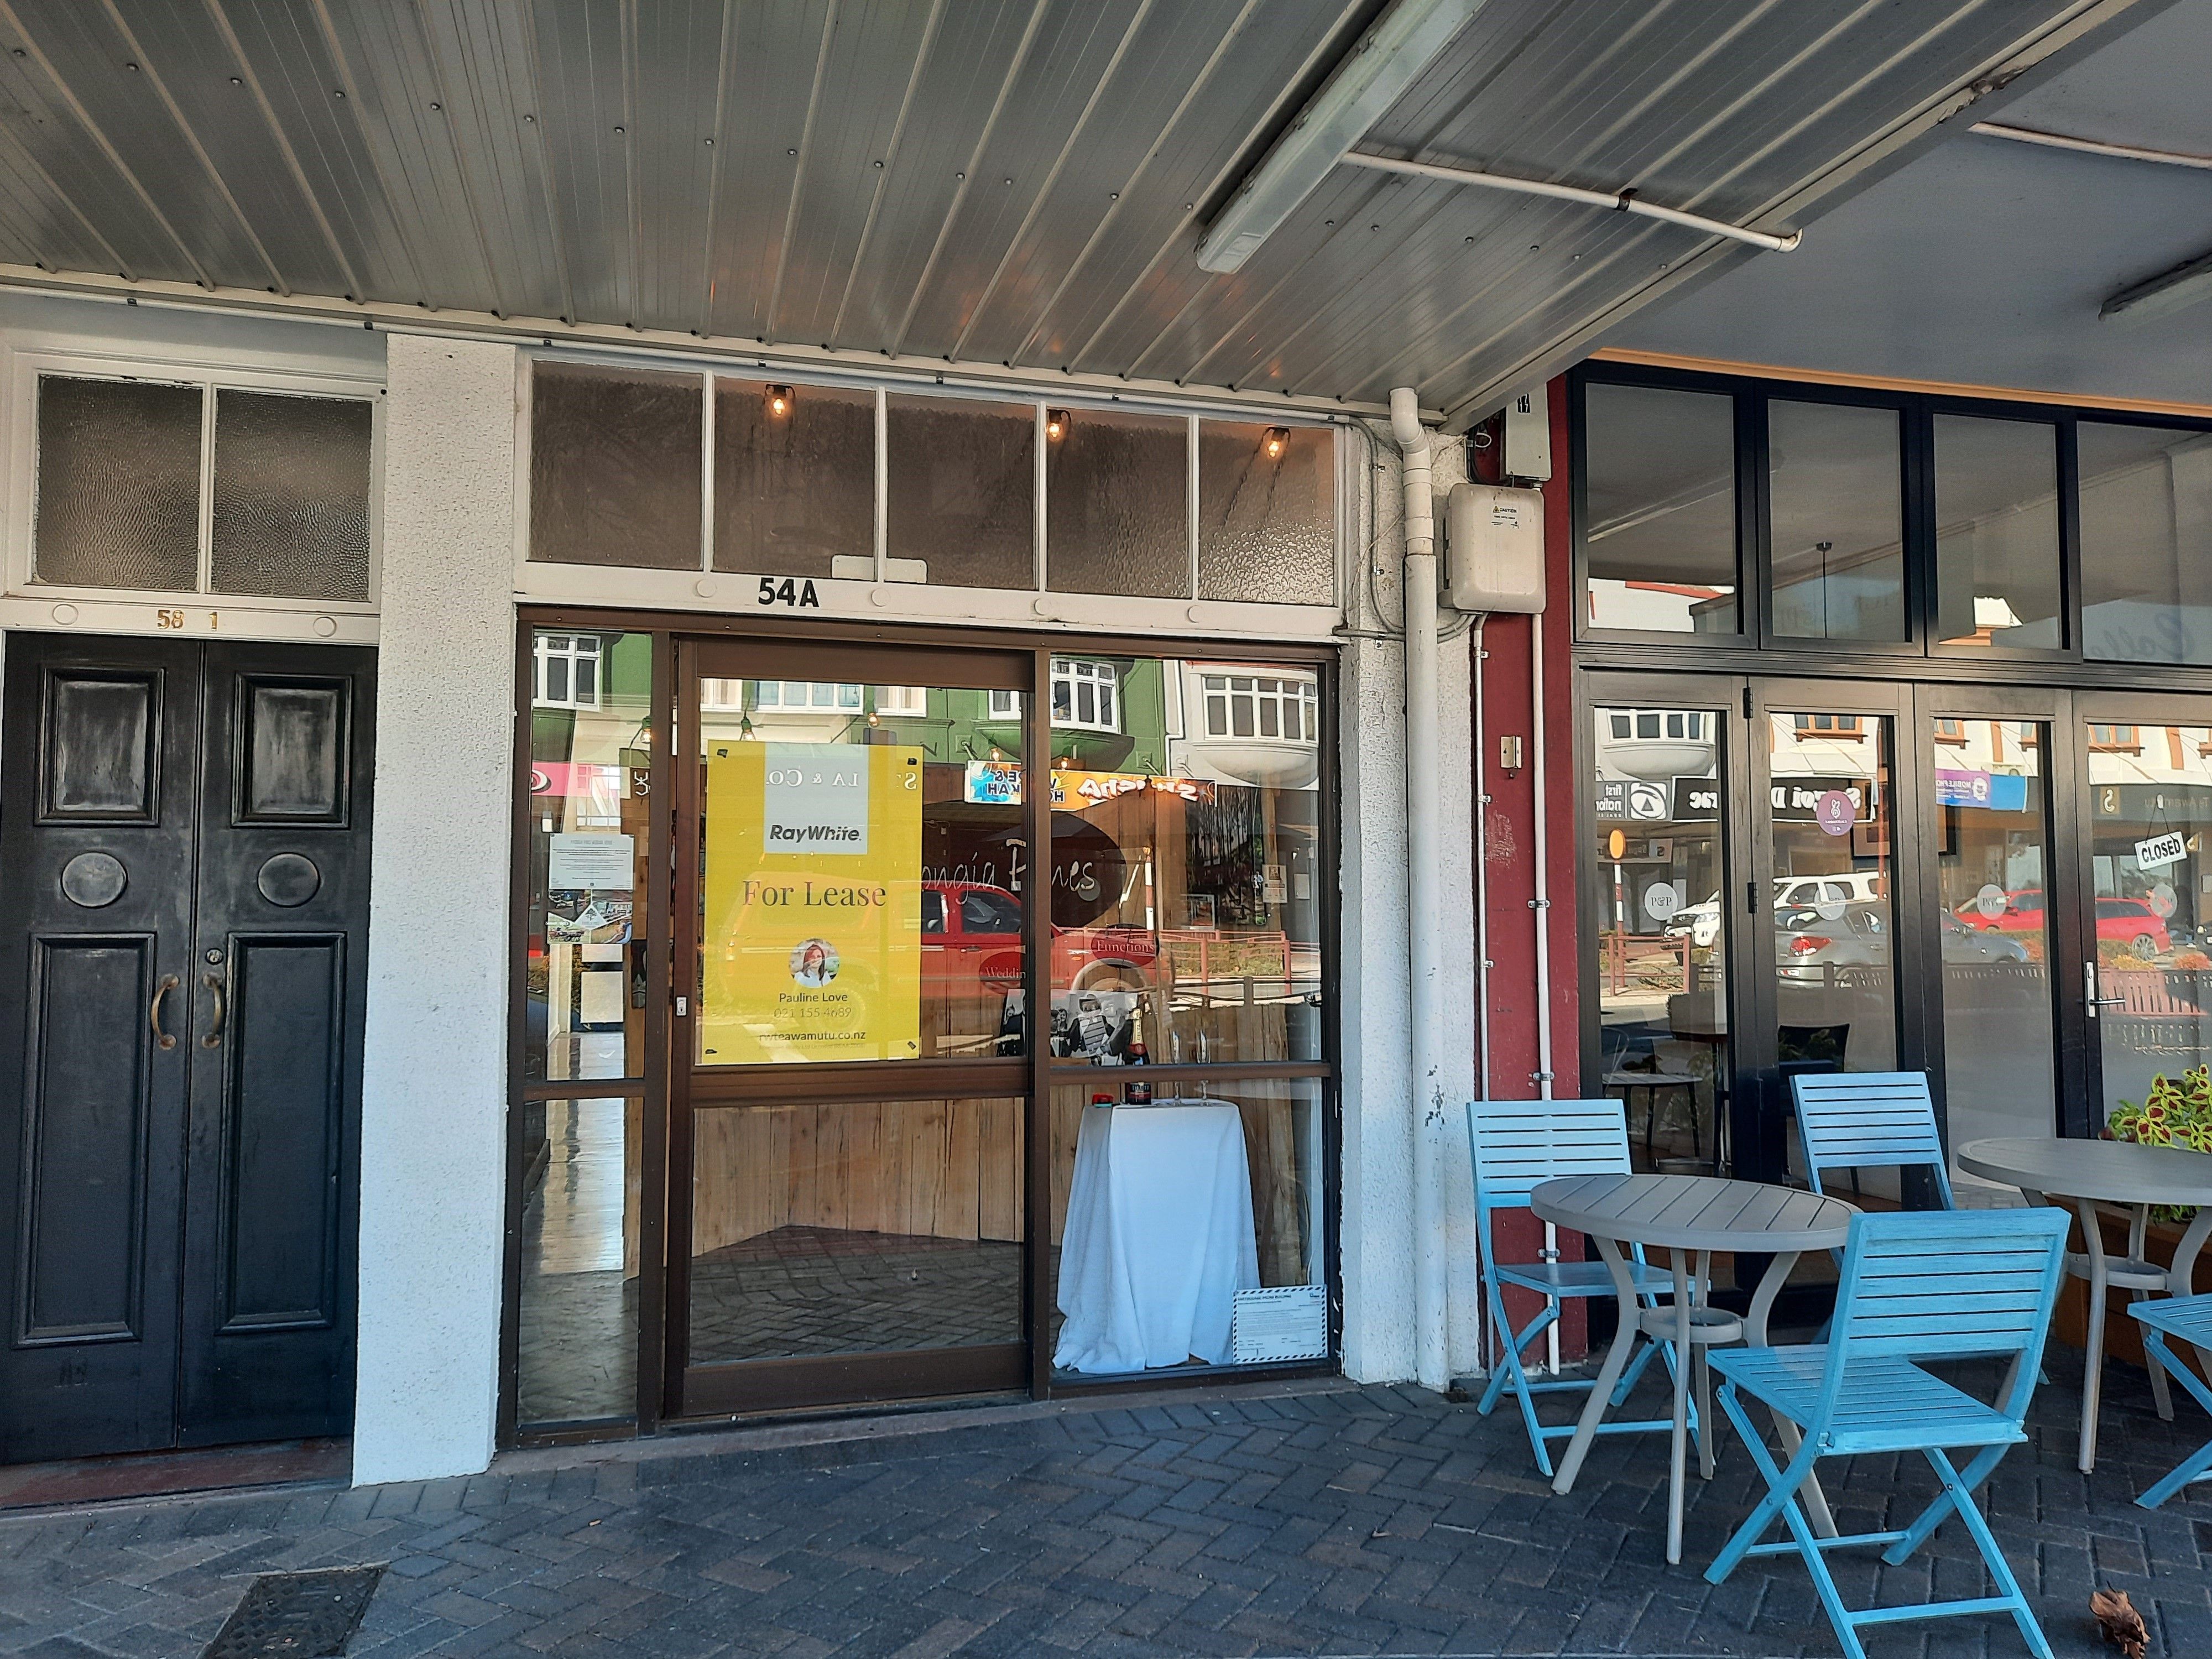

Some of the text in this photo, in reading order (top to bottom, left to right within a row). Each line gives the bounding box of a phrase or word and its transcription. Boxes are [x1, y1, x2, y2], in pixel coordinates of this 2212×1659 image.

[758, 577, 820, 607] 54A
[156, 609, 218, 632] 58 1
[2141, 839, 2181, 863] CLOSED
[742, 880, 886, 907] For Lease
[1651, 896, 1672, 906] P&P
[1097, 940, 1155, 953] Functions
[779, 993, 848, 1003] Pauline Love
[774, 1007, 852, 1018] 021 155 4689
